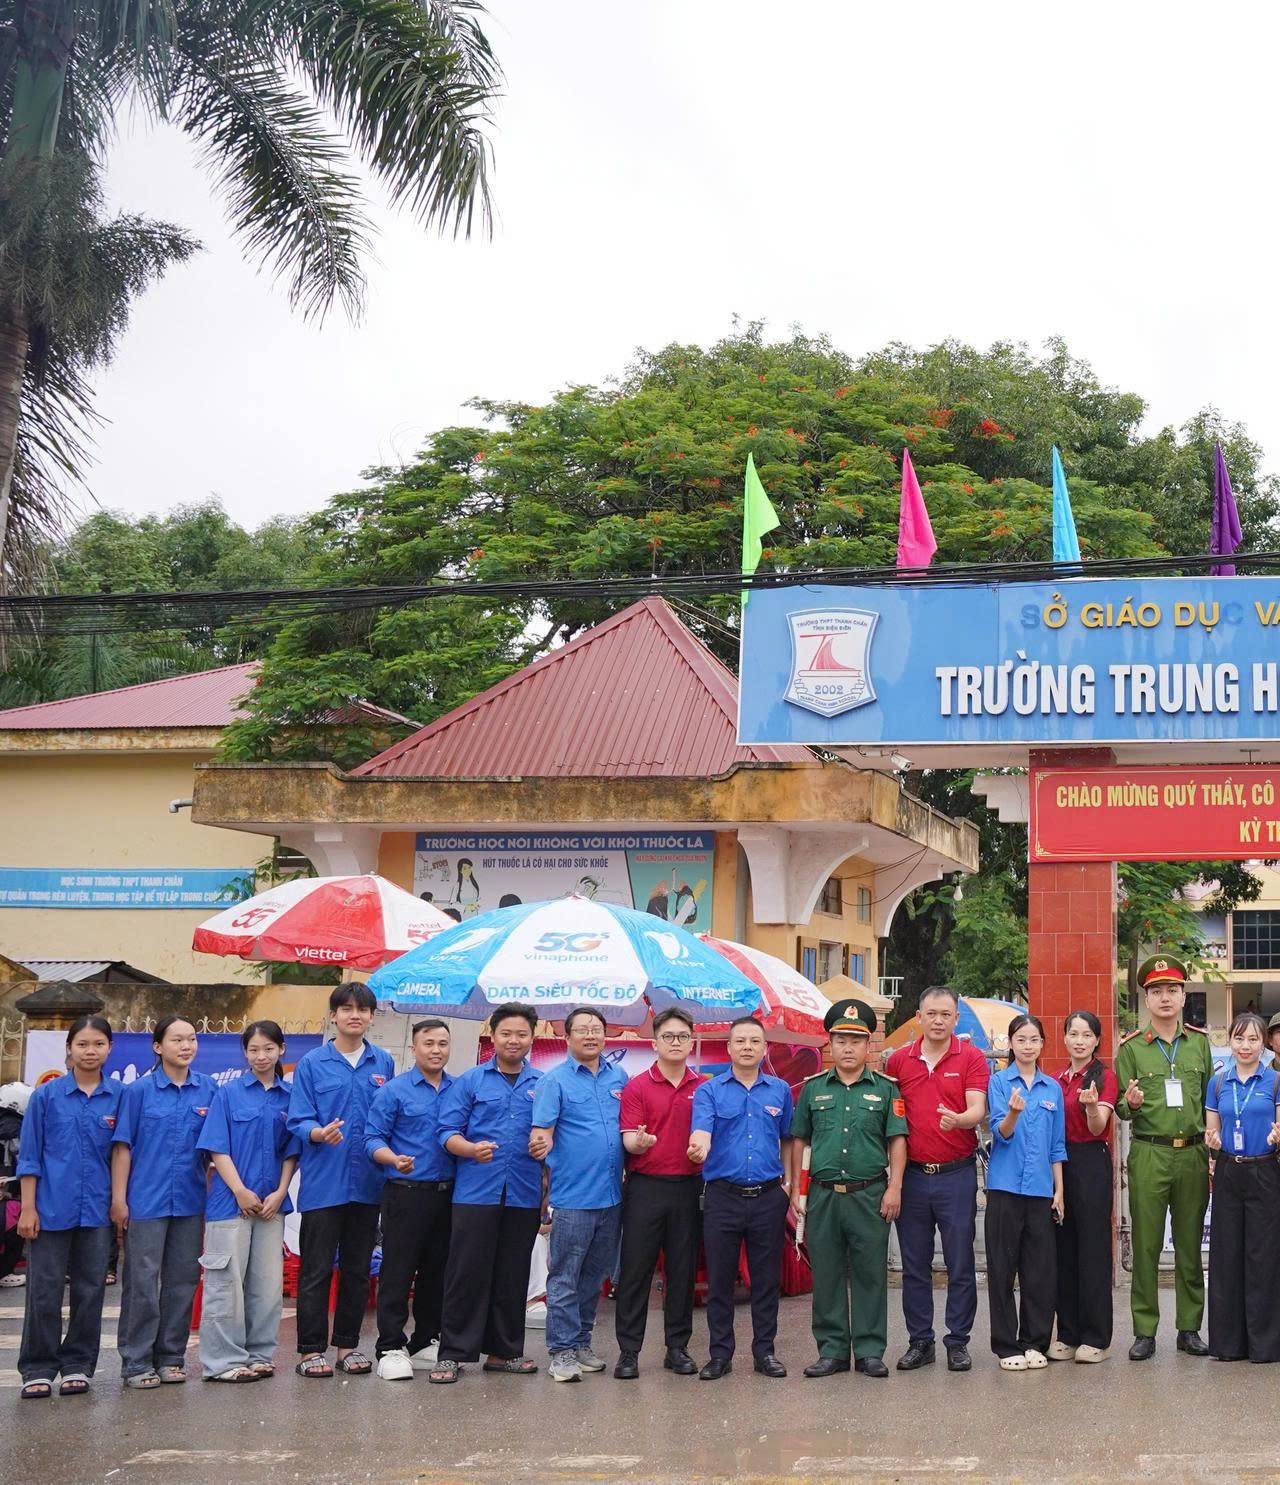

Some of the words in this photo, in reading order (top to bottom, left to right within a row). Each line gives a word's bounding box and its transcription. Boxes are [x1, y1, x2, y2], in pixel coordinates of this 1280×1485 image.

[1080, 596, 1162, 628] GIÁO
[814, 684, 844, 694] 2002
[935, 649, 1095, 715] TRƯỜNG
[1109, 663, 1240, 714] TRUNG
[1056, 782, 1102, 807] CHÀO
[1107, 781, 1158, 807] MỪNG
[1164, 780, 1196, 809] QUÝ
[1202, 777, 1247, 808] THẦY,
[1252, 779, 1275, 805] CÔ
[1239, 816, 1262, 842] KỲ
[479, 838, 504, 850] HỌC
[544, 858, 555, 870] HẠI
[557, 859, 572, 868] CHO
[231, 907, 277, 929] 5G
[294, 946, 348, 961] viettel
[524, 953, 609, 962] vinaphone
[396, 982, 440, 996] CAMERA
[487, 986, 529, 998] DATA
[575, 980, 609, 998] TỐC
[614, 984, 637, 1001] ĐỘ
[682, 985, 737, 1001] INTERNET
